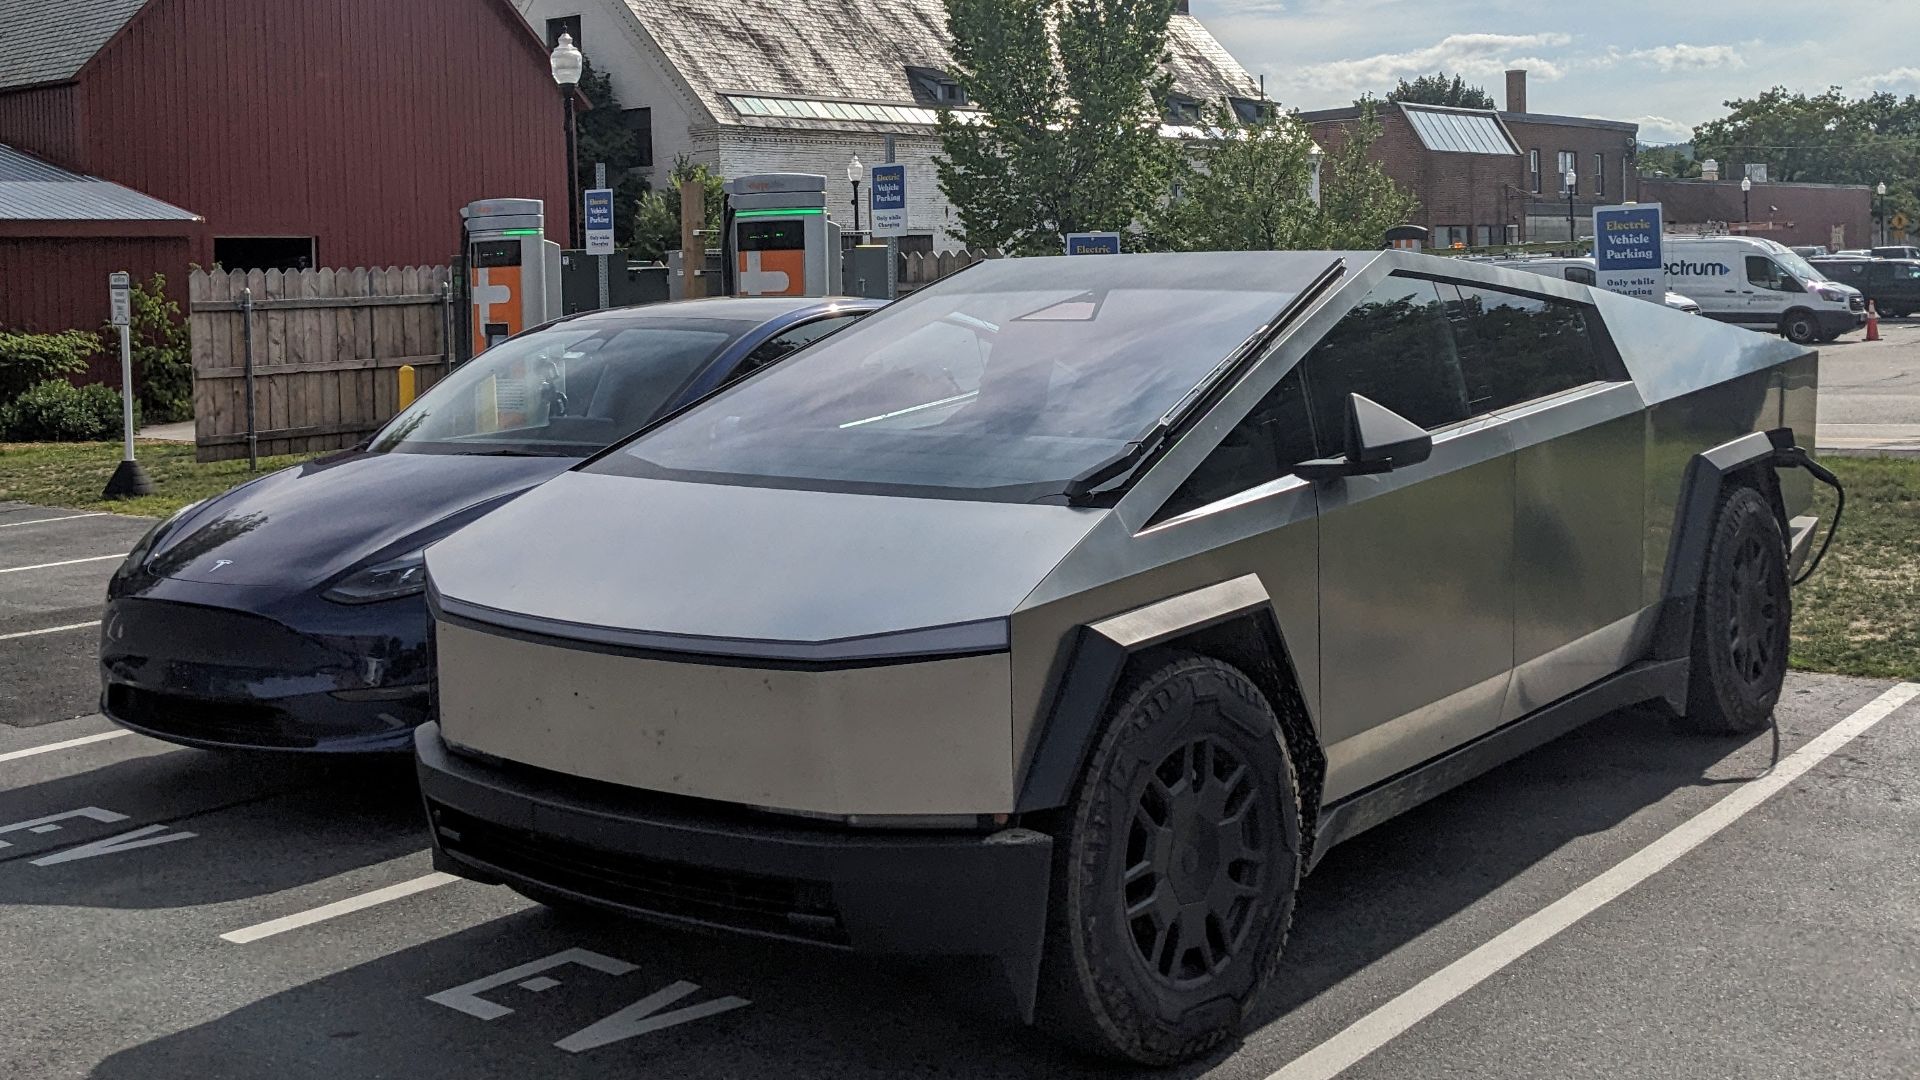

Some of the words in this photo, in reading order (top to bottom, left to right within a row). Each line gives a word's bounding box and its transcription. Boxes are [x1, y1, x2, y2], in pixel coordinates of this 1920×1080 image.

[877, 183, 899, 191] Vehicle
[876, 194, 901, 202] Parking
[1606, 219, 1650, 231] Electric
[1608, 233, 1650, 245] Vehicle
[1076, 245, 1111, 254] Electric
[1606, 249, 1653, 260] Parking
[1664, 260, 1724, 276] ectrum
[1606, 279, 1629, 287] Only
[425, 947, 753, 1052] EV
